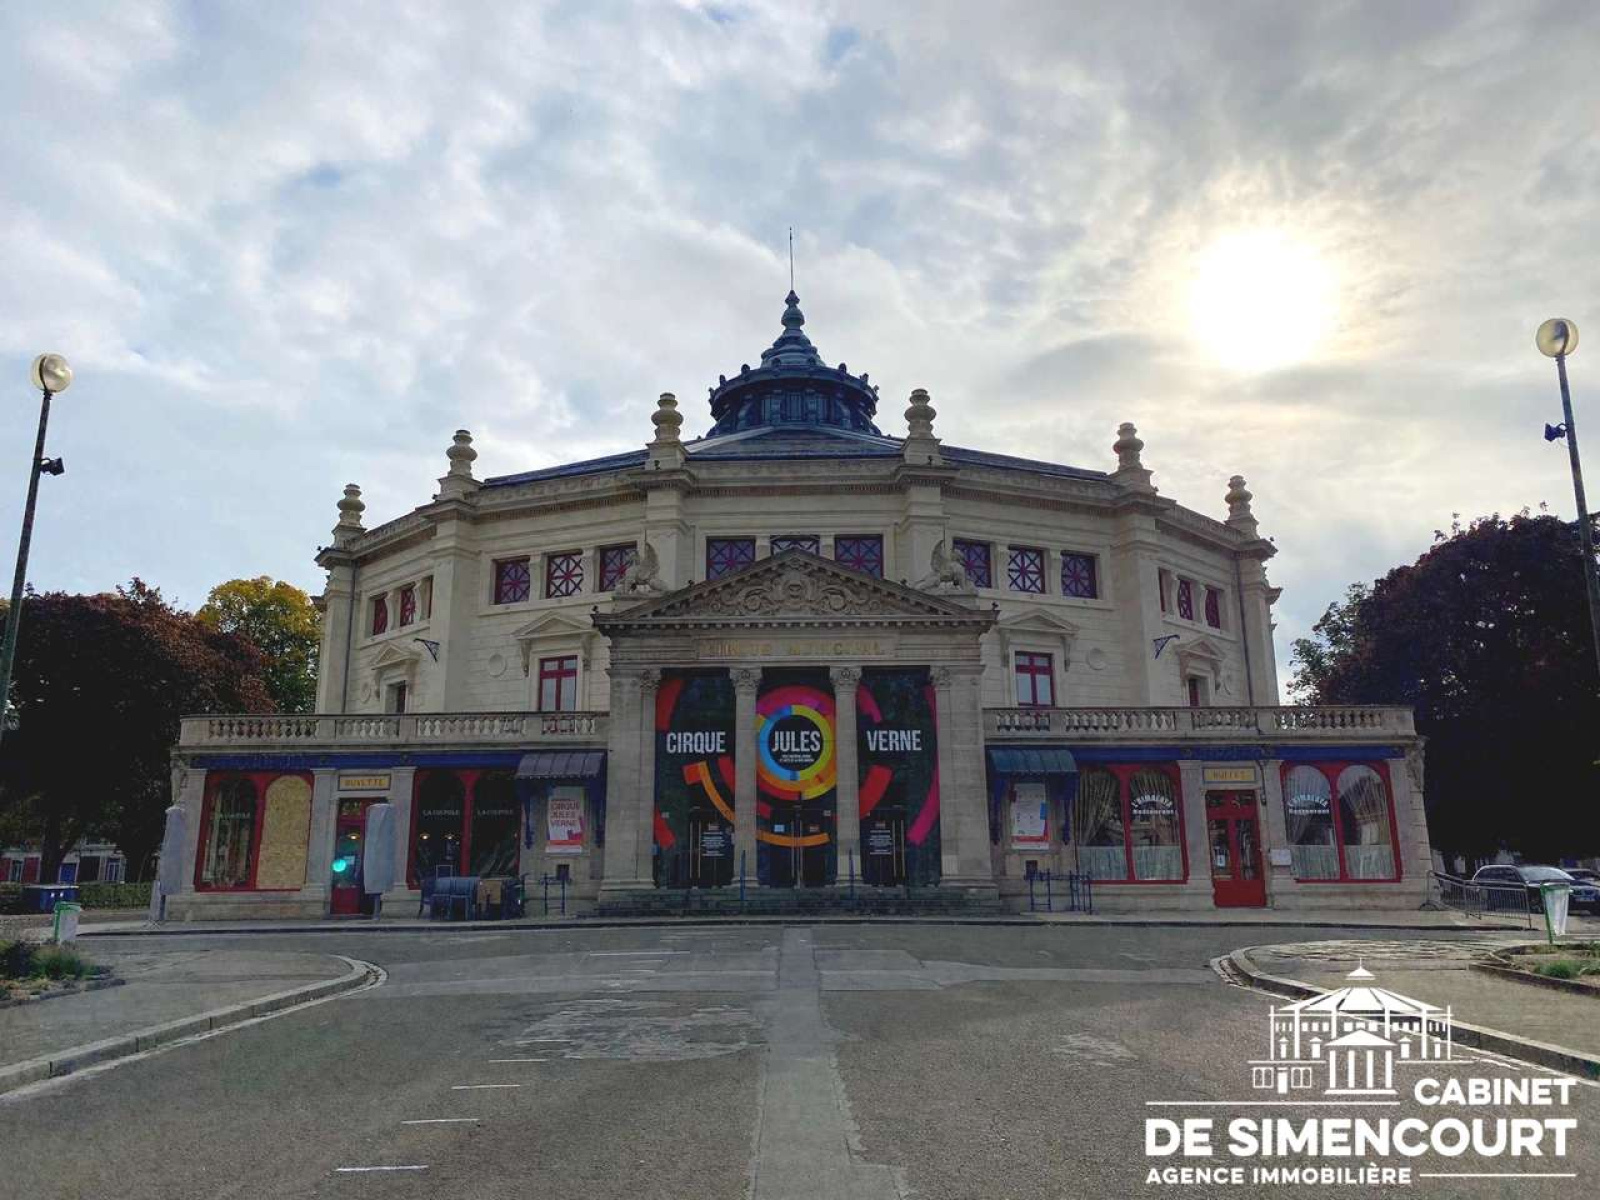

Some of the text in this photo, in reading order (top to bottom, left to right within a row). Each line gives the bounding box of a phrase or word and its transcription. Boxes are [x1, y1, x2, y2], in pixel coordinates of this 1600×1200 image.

[666, 731, 727, 753] CIRQUE
[772, 731, 821, 752] JULES
[867, 730, 922, 751] VERNE
